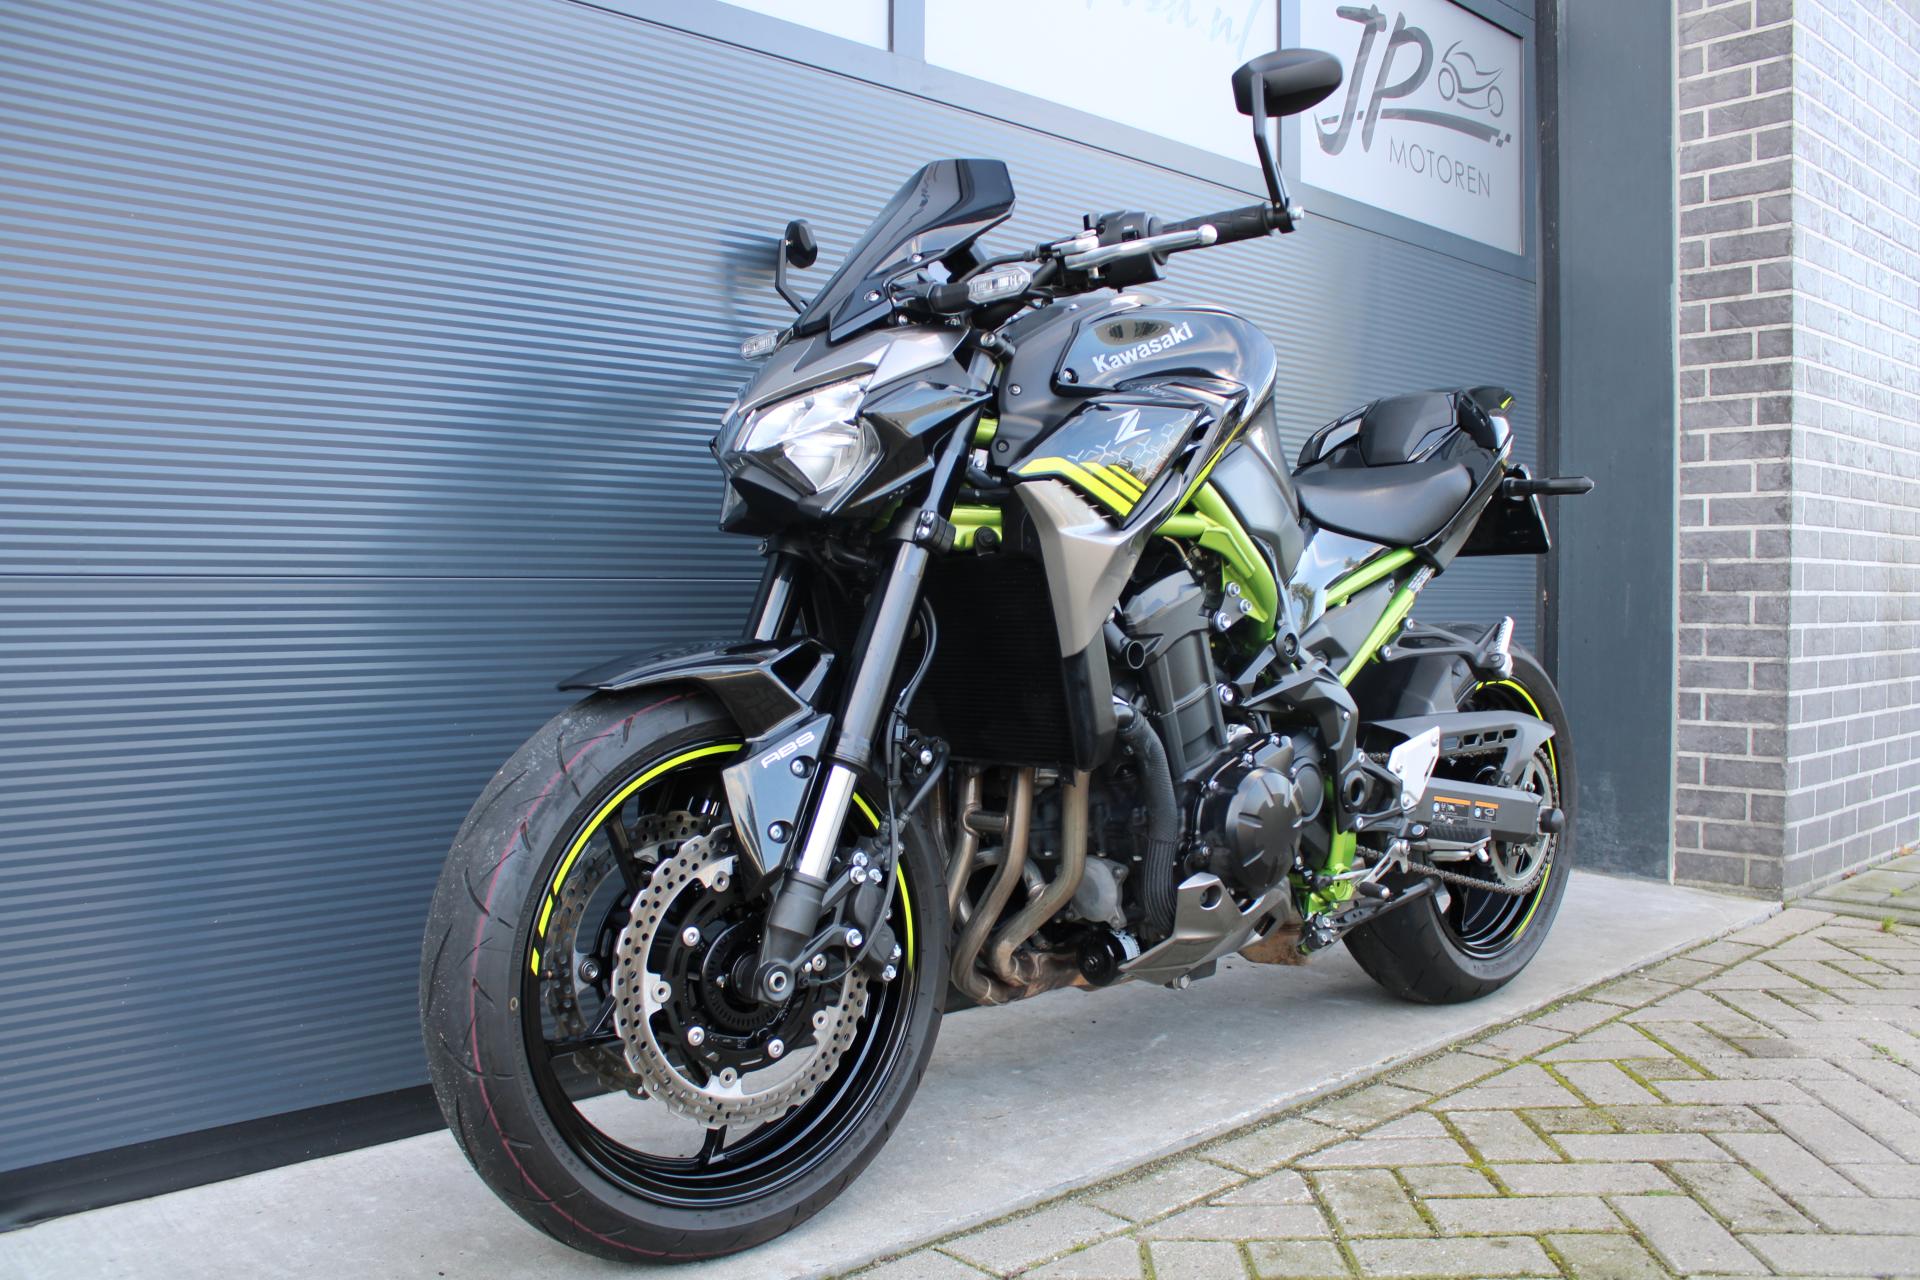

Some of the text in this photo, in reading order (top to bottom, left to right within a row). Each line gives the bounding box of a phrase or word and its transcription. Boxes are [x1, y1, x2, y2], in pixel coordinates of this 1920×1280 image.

[1389, 137, 1491, 198] MOTOREN
[1092, 322, 1194, 373] Kawasaki
[761, 731, 815, 768] ABS
